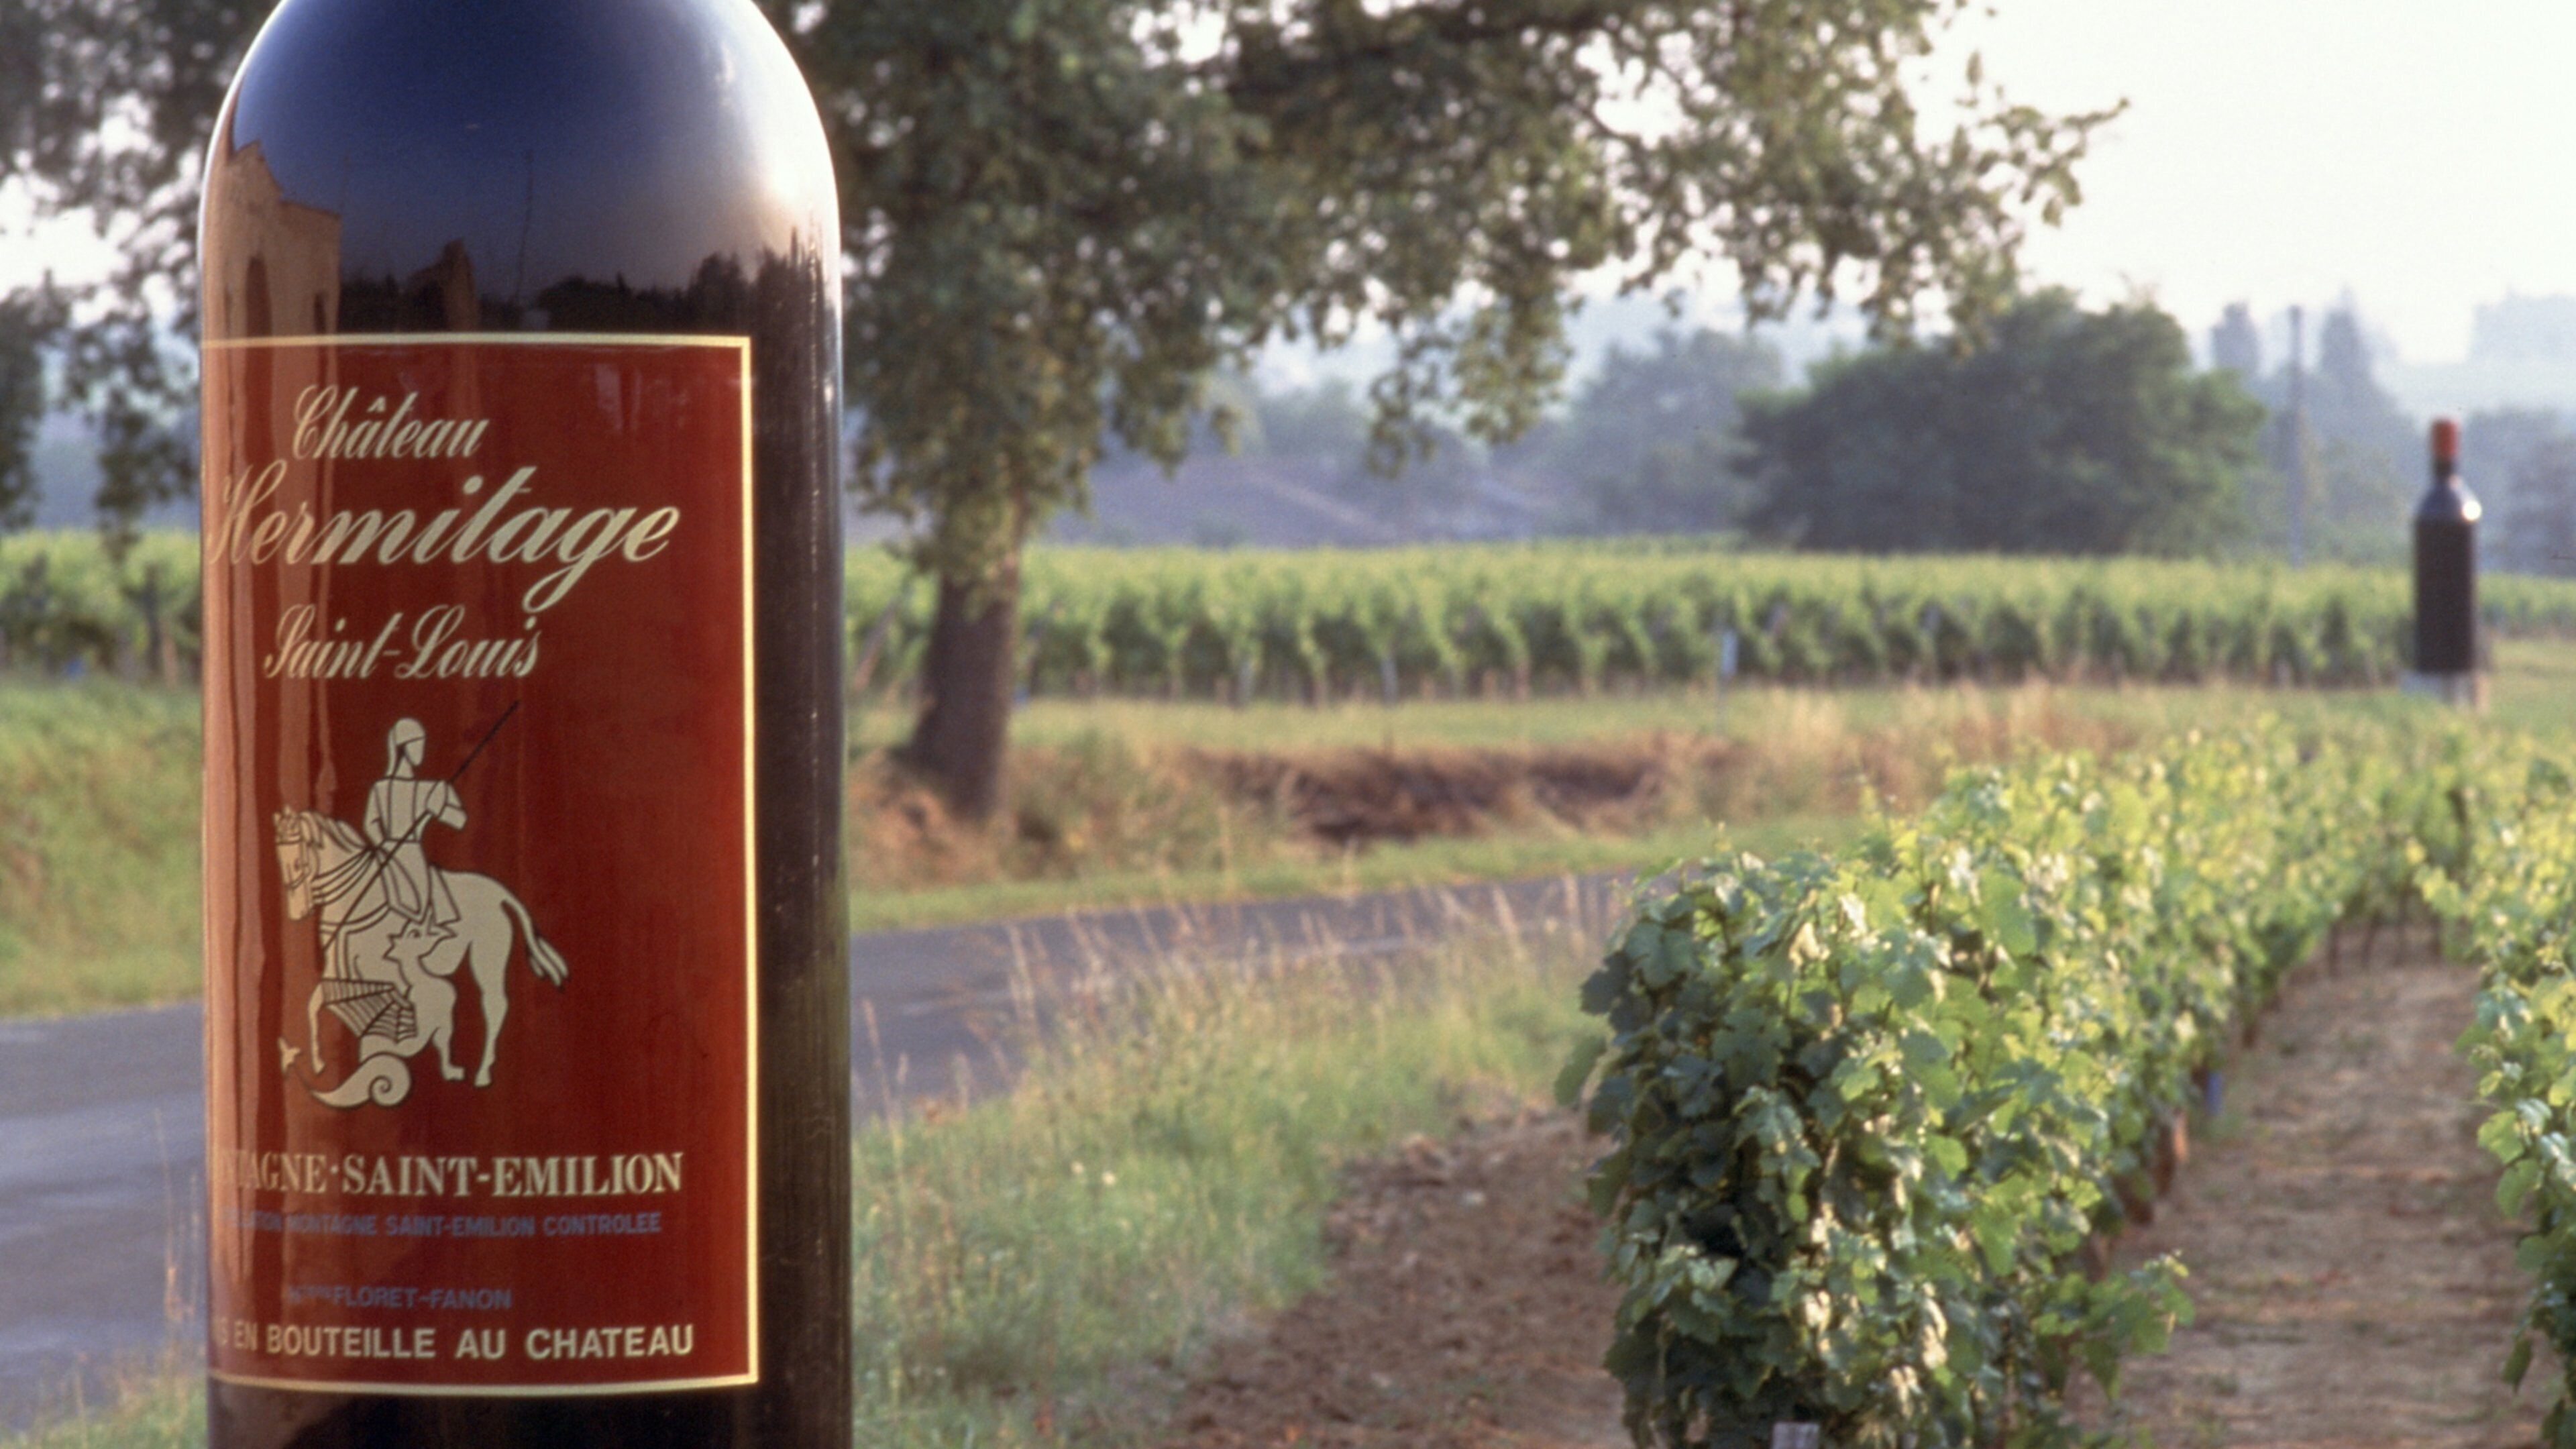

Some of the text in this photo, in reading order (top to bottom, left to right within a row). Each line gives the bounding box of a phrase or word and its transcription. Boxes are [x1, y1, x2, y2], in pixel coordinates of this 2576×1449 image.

[292, 384, 489, 459] Château
[205, 460, 680, 613] Hermitage
[264, 604, 542, 679] Saint-Louis
[386, 1214, 535, 1237] SAINT-EMILION
[543, 1212, 662, 1235] CONTROLEE
[235, 1319, 258, 1351] EN
[266, 1324, 437, 1359] BOUTEILLE
[455, 1328, 506, 1360] AU
[525, 1324, 694, 1360] CHATEAU
